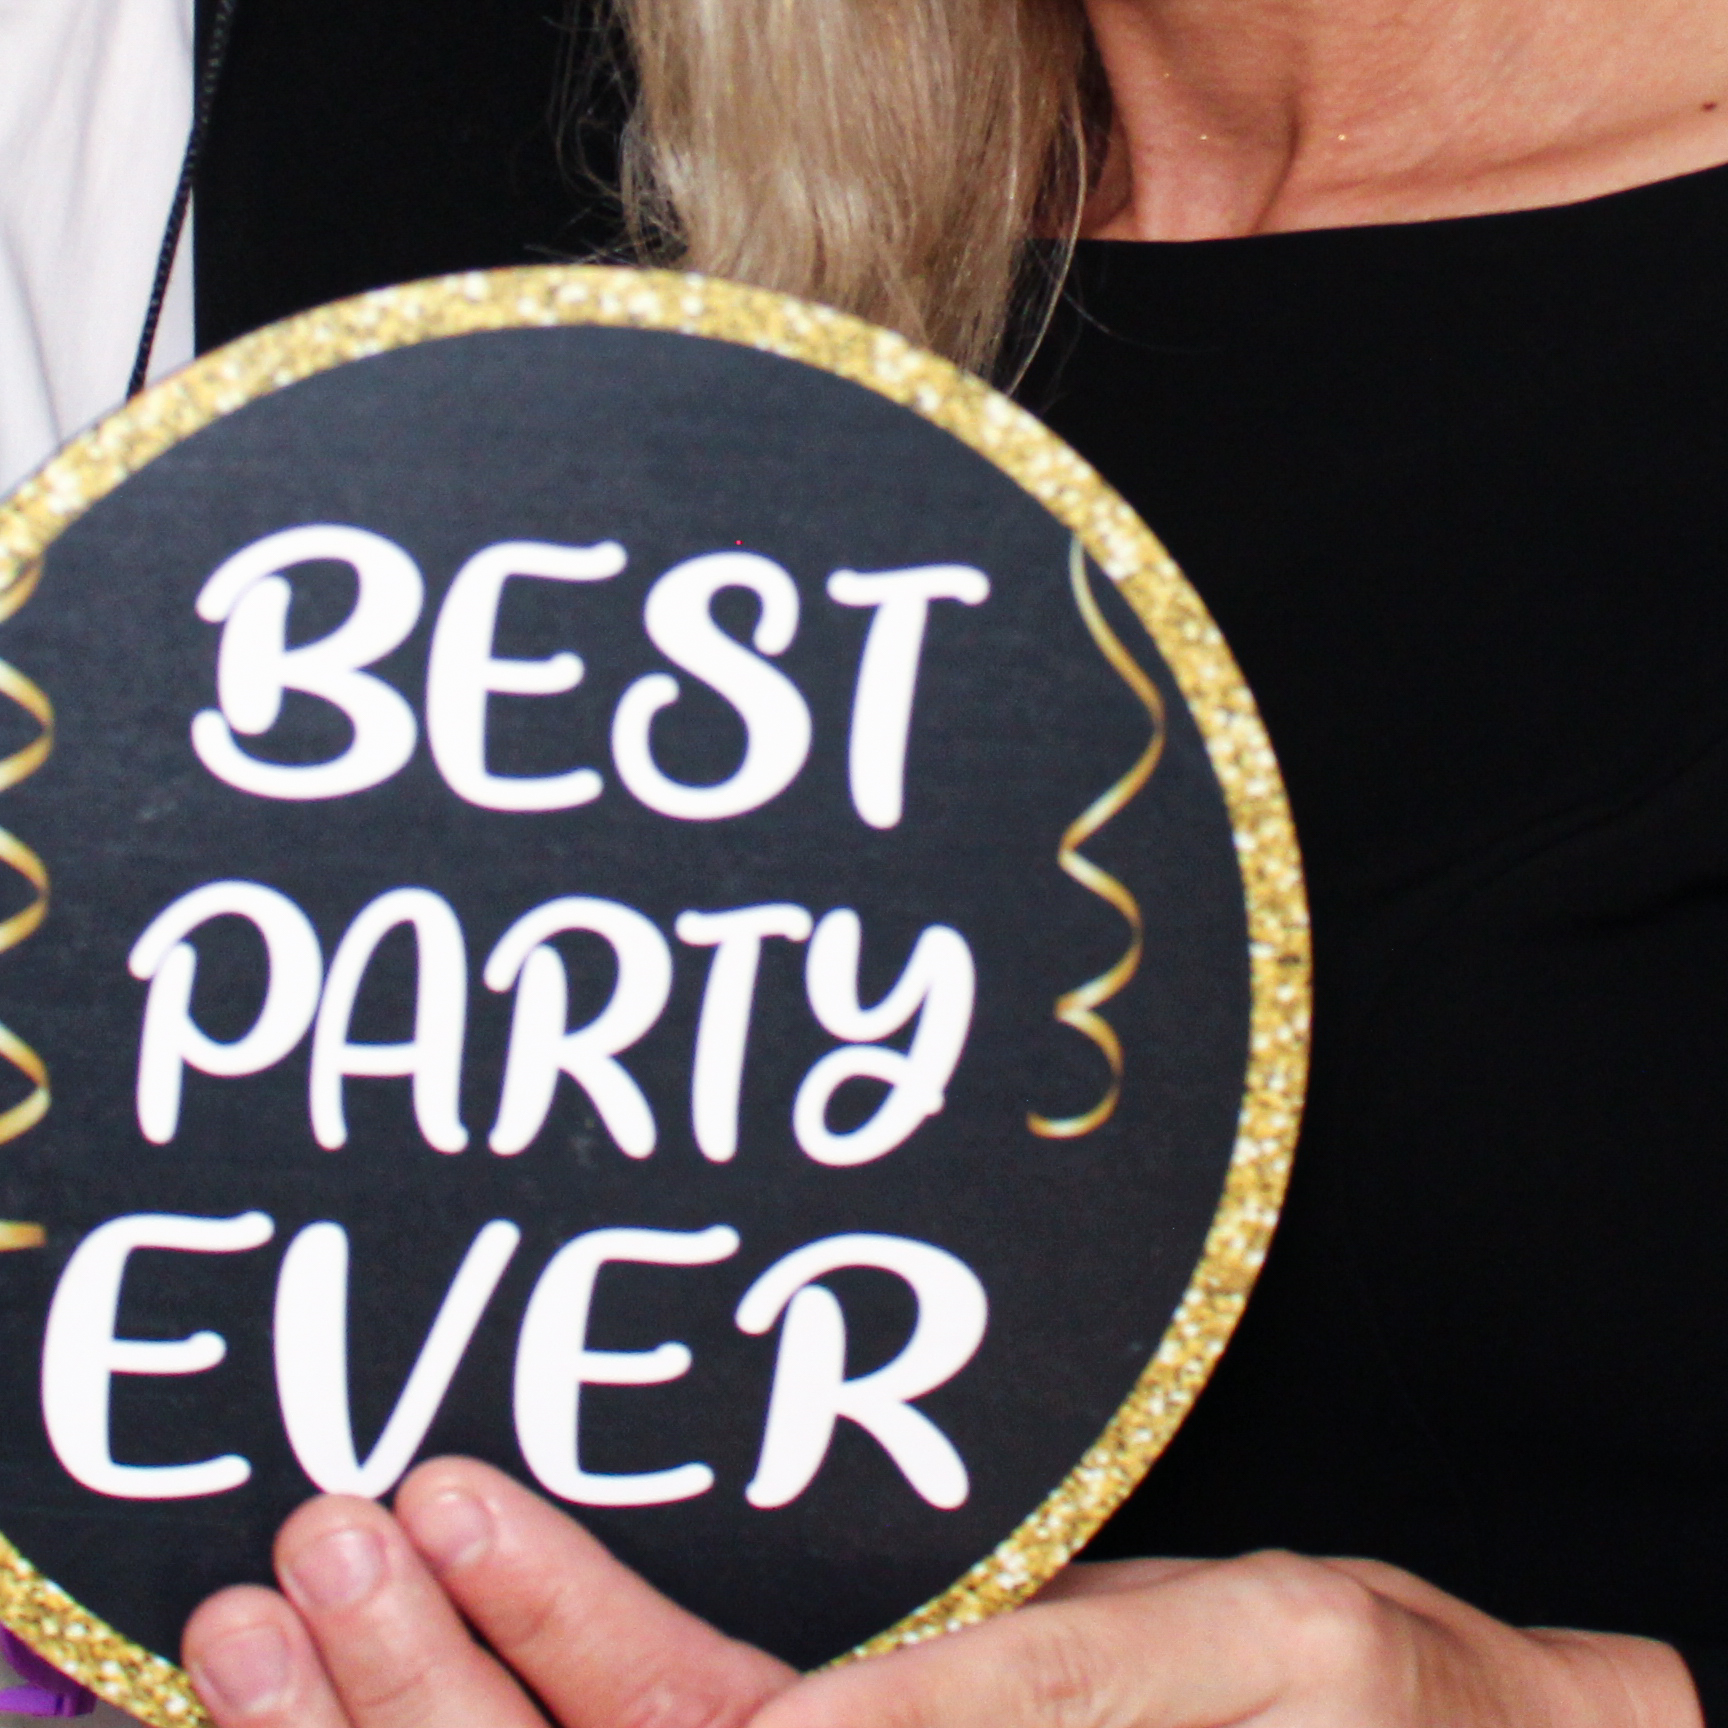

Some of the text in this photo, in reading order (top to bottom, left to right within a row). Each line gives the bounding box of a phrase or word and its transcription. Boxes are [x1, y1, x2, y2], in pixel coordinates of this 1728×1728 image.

[191, 524, 990, 828] BEST
[129, 881, 975, 1166] PARTY
[42, 1212, 988, 1509] EVER
